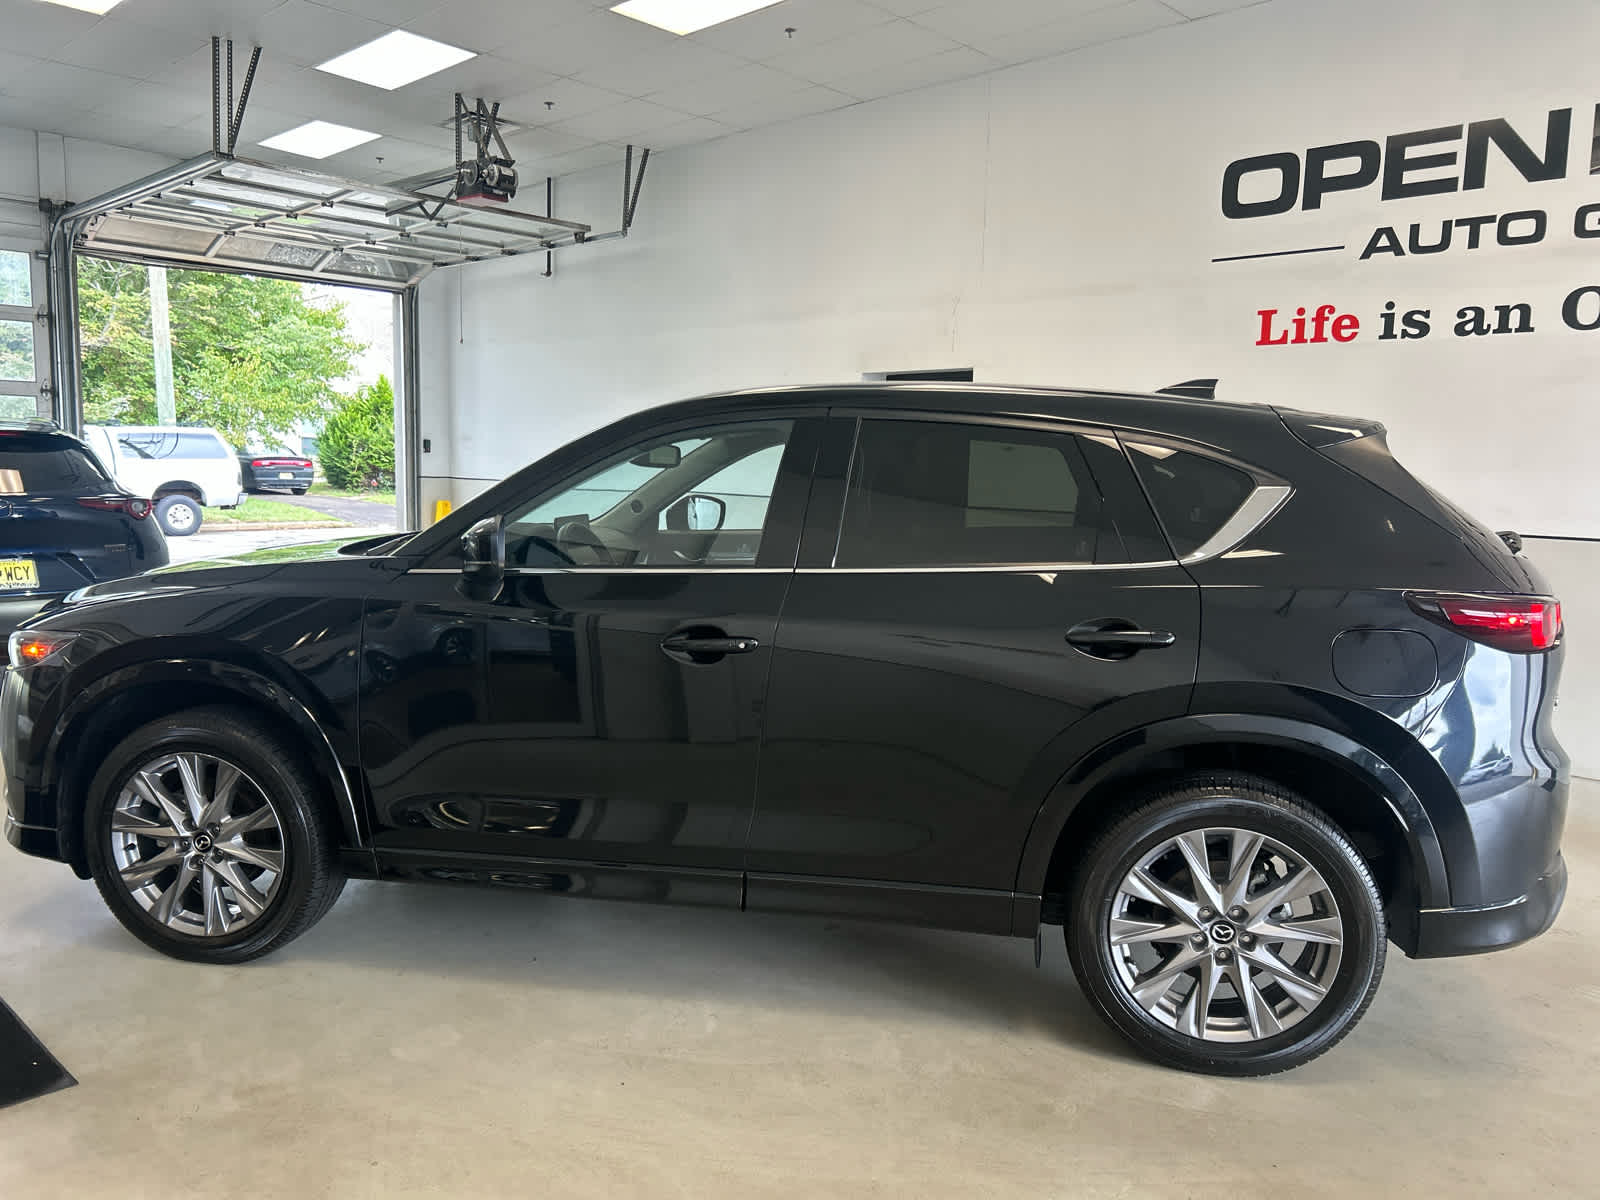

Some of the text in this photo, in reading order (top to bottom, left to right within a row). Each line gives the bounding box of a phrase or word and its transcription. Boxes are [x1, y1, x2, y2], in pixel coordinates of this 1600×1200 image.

[1222, 107, 1573, 220] OPEN
[1358, 209, 1547, 261] AUTO
[1255, 304, 1360, 346] Life
[1378, 300, 1431, 340] is
[1453, 302, 1535, 337] an
